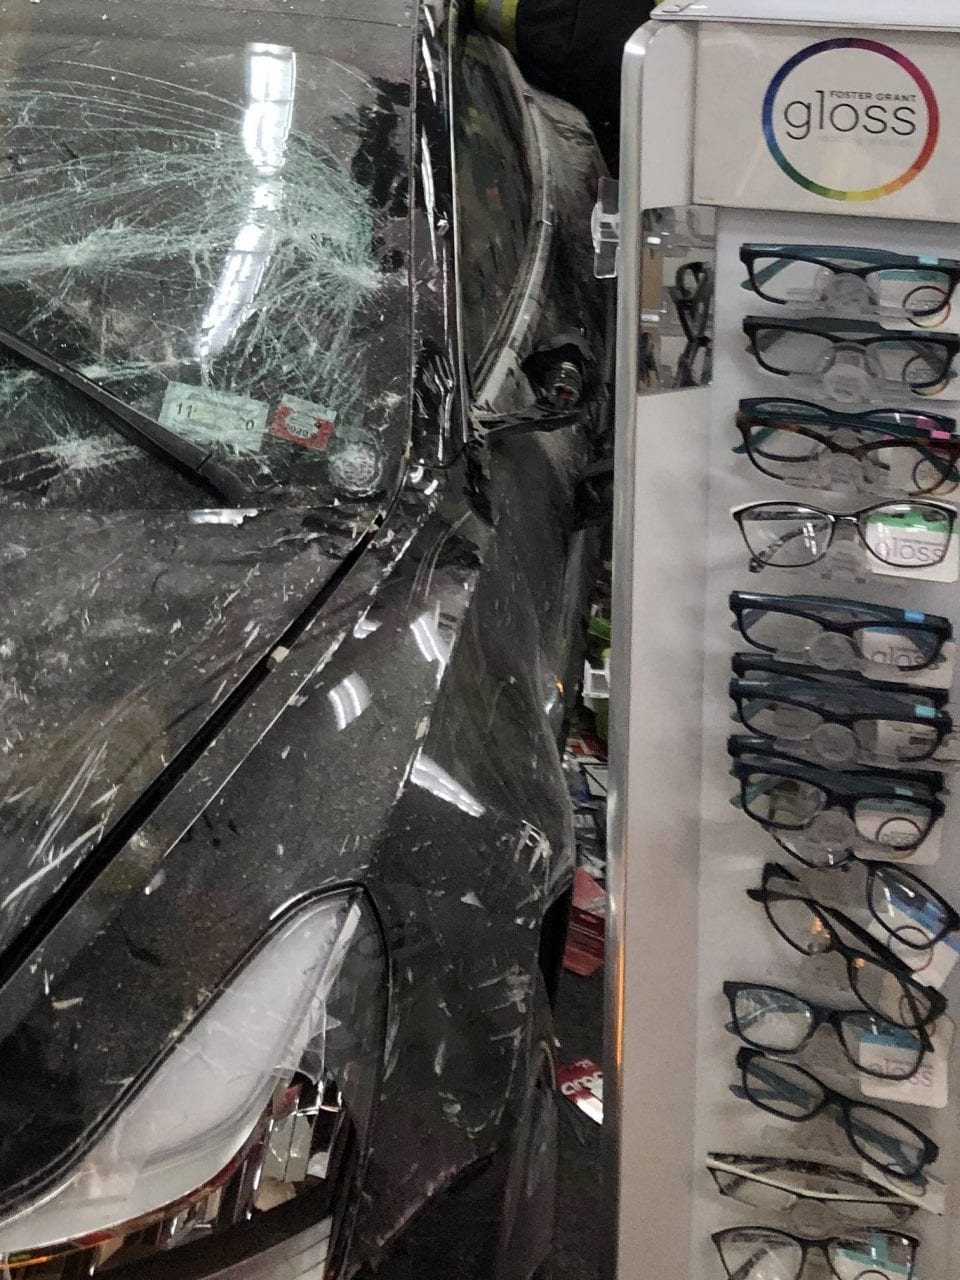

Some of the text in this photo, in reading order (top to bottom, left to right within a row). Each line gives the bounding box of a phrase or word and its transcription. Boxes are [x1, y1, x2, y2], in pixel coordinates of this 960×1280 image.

[830, 90, 916, 103] FOSTER GRANT
[784, 89, 916, 140] gloss
